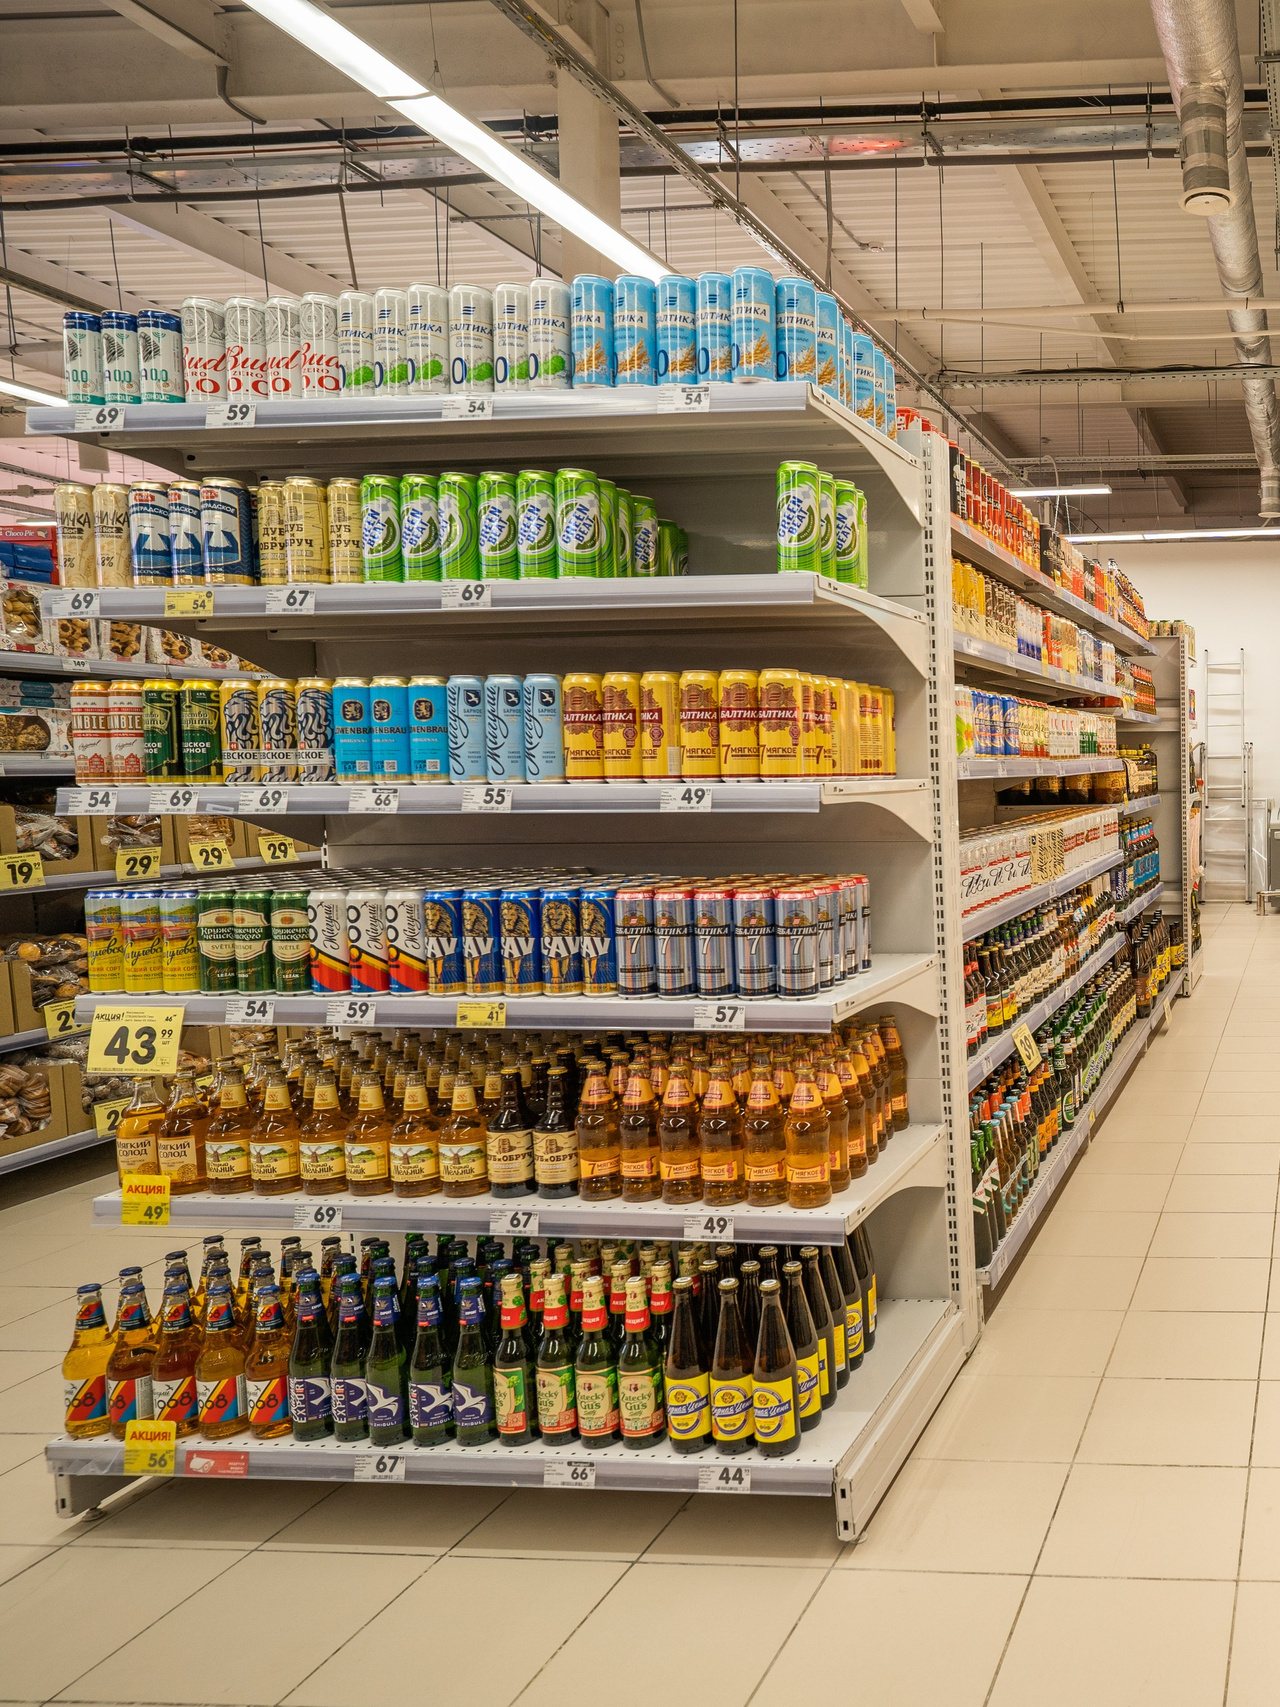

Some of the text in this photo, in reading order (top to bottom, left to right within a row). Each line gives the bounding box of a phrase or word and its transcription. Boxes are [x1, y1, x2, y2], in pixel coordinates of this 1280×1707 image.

[268, 350, 301, 371] ud
[468, 401, 485, 413] 54
[685, 393, 703, 405] 54
[96, 408, 119, 424] 69
[226, 404, 250, 421] 59
[517, 504, 541, 546] GREEN
[560, 503, 590, 545] GREEN
[777, 495, 804, 539] GREEN
[788, 508, 809, 537] BEAT
[402, 507, 424, 550] GREEN
[408, 520, 430, 547] BEAT
[478, 506, 503, 547] GREEN
[487, 519, 510, 546] BEAT
[526, 516, 548, 544] BEAT
[575, 515, 595, 543] BEAT
[286, 590, 309, 606] 67
[461, 584, 485, 601] 69
[71, 593, 94, 610] 69
[192, 599, 207, 610] 54
[563, 713, 602, 721] БАЛТИКА
[680, 711, 717, 720] БАЛТИКА
[758, 710, 798, 719] БАЛТИКА
[223, 752, 258, 760] ЕВСКОЕ
[722, 744, 731, 764] 7
[766, 746, 797, 754] МЯГКОЕ
[88, 792, 111, 808] 54
[170, 790, 193, 807] 69
[259, 790, 282, 807] 69
[374, 795, 391, 806] 66
[483, 788, 506, 805] 55
[681, 788, 706, 804] 49
[199, 847, 223, 866] 29
[267, 842, 287, 859] 29
[7, 862, 33, 884] 19
[126, 855, 152, 876] 29
[779, 926, 817, 935] БАЛТИКА
[626, 935, 641, 954] 7
[658, 936, 671, 955] 7
[699, 936, 711, 955] 7
[747, 935, 761, 955] 7
[790, 935, 804, 955] 7
[94, 1012, 125, 1021] АКЦИЯ!
[245, 1001, 268, 1018] 54
[347, 1002, 370, 1018] 59
[487, 1011, 499, 1021] 41
[715, 1006, 739, 1022] 57
[104, 1026, 173, 1065] 43 99
[1020, 1034, 1036, 1061] 39
[588, 1160, 619, 1175] 7 МЯГКОЕ
[665, 1164, 697, 1177] 7 МЯГКОЕ
[747, 1167, 777, 1179] 7 МЯГКОЕ
[789, 1169, 795, 1180] 7
[126, 1183, 166, 1195] АКЦИЯ!
[144, 1206, 163, 1220] 49
[314, 1207, 336, 1223] 69
[509, 1212, 533, 1228] 67
[703, 1217, 728, 1234] 49
[297, 1378, 306, 1424] EXPORT
[338, 1378, 347, 1424] EXPORT
[410, 1383, 420, 1428] EXPORT
[429, 1416, 453, 1427] ZHIGULI
[130, 1430, 172, 1441] АКЦИЯ!
[148, 1454, 168, 1468] 56
[375, 1456, 399, 1473] 67
[571, 1467, 588, 1480] 66
[718, 1467, 744, 1485] 44
